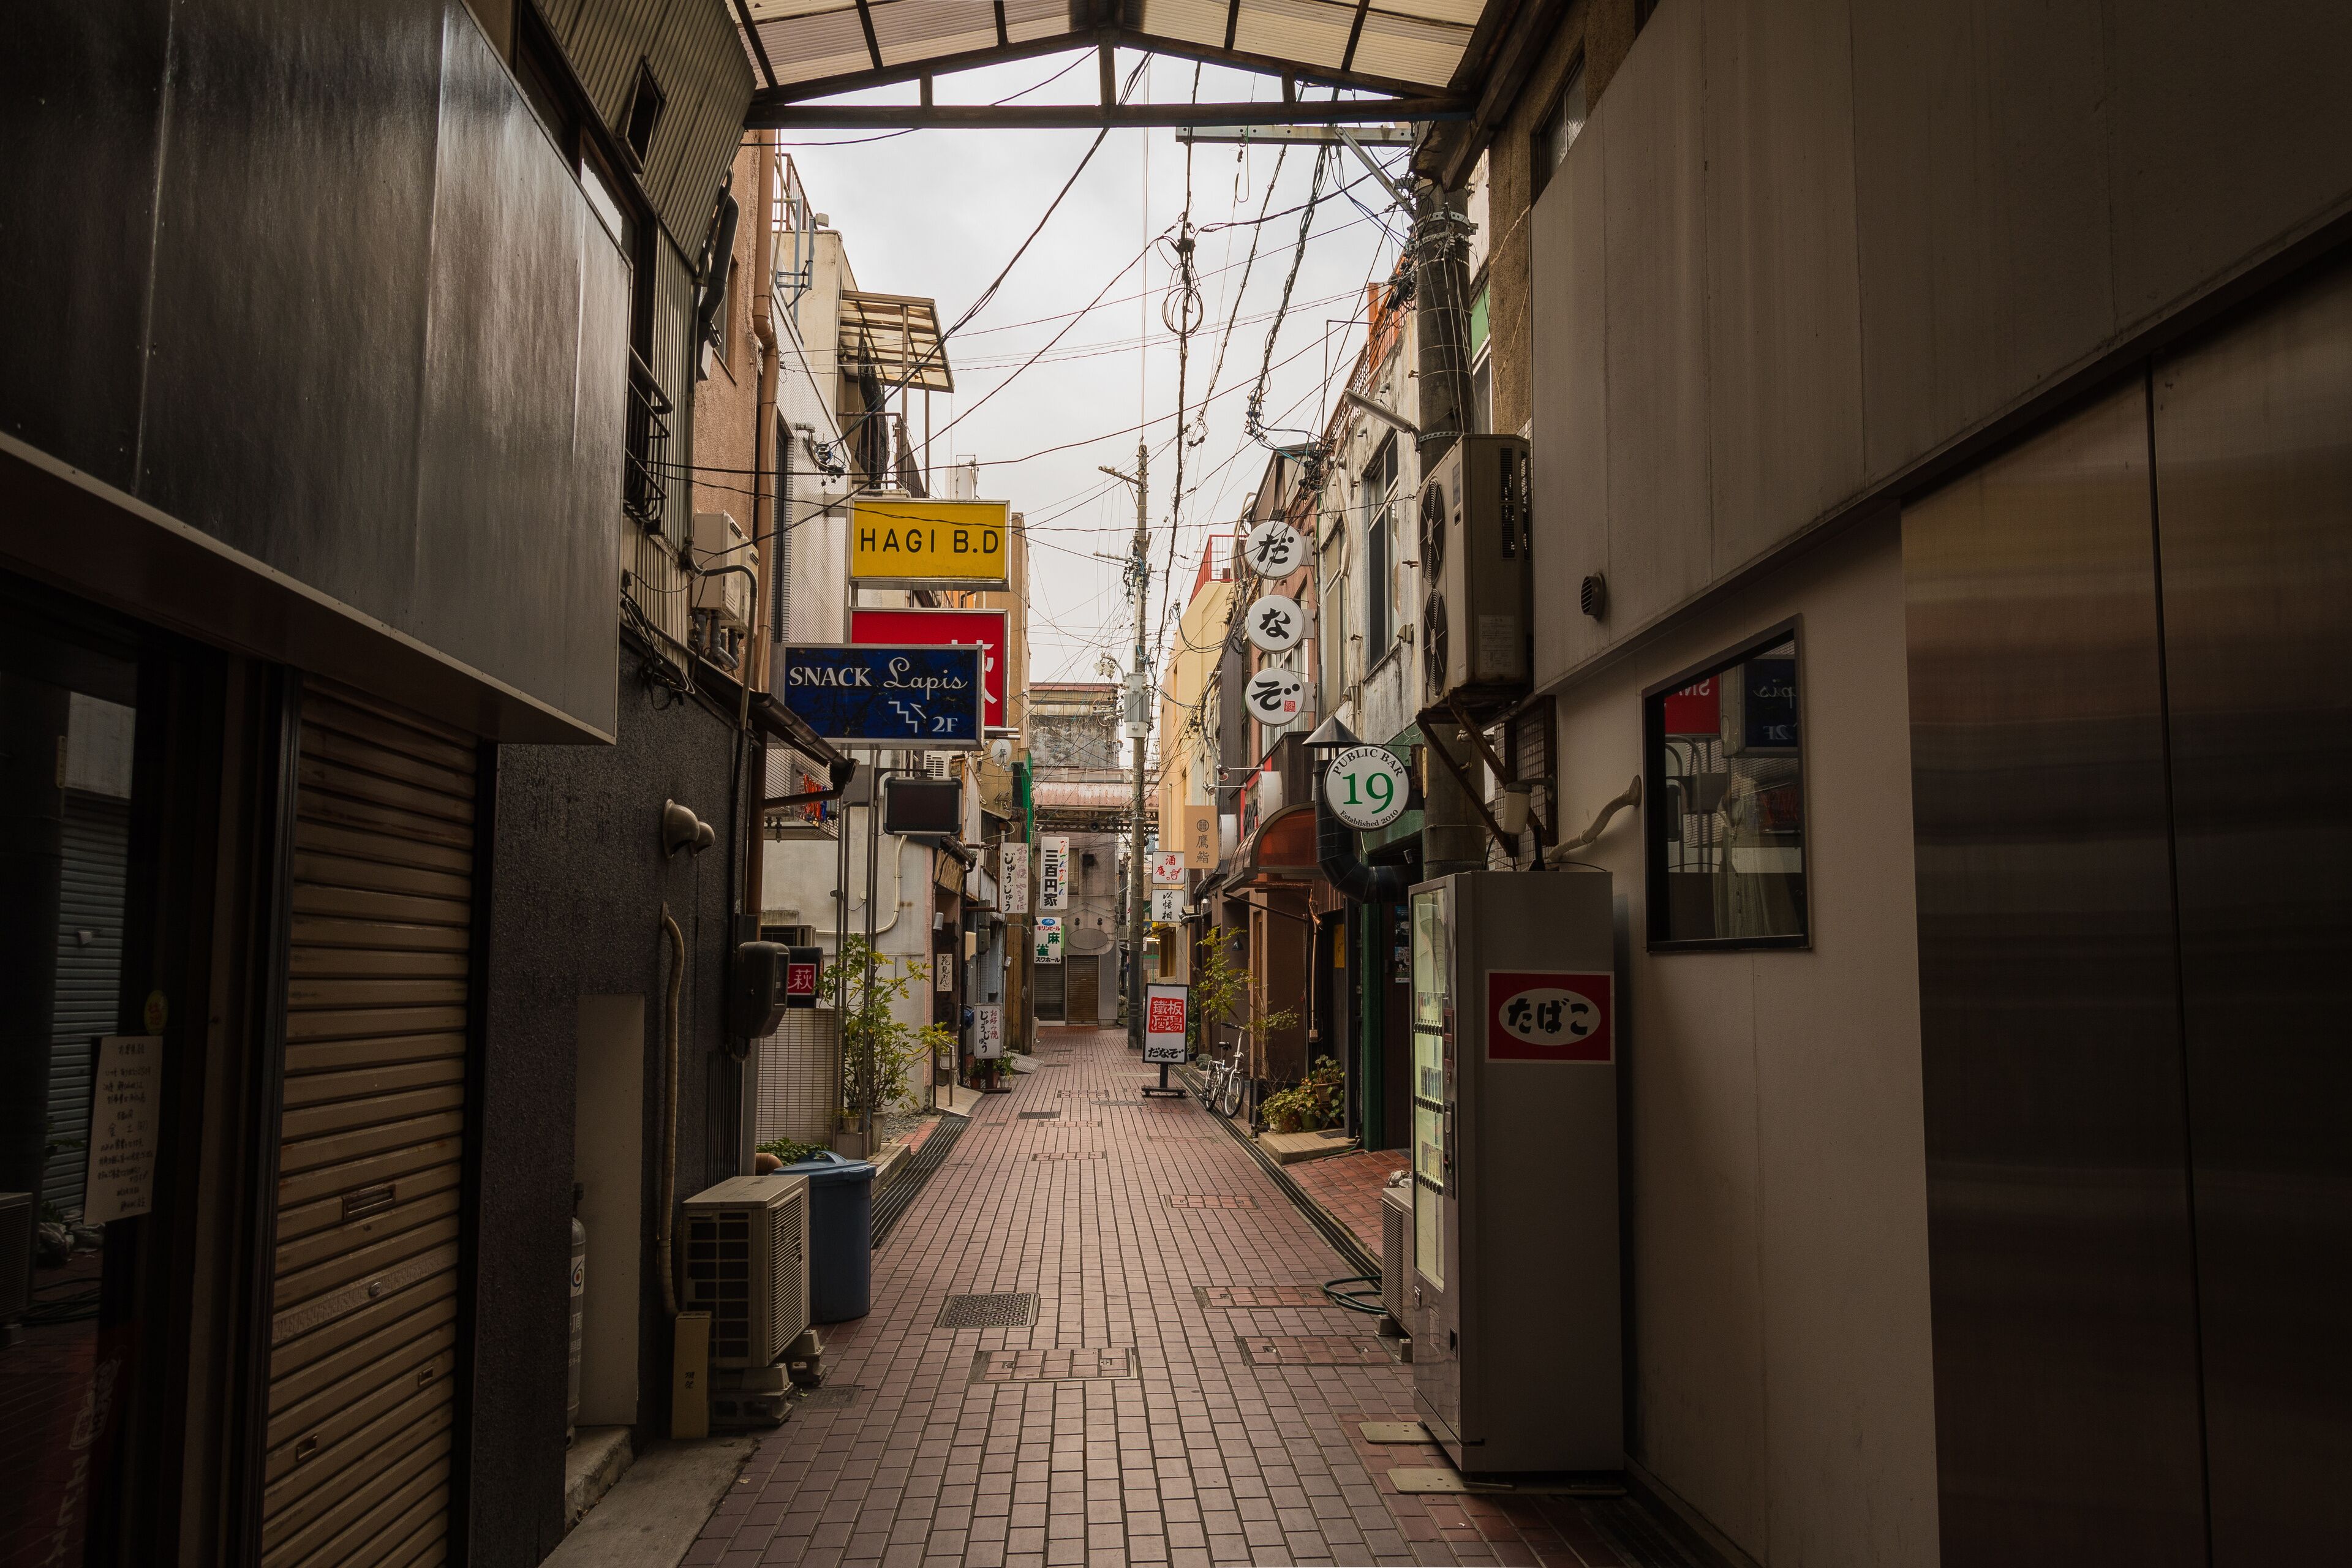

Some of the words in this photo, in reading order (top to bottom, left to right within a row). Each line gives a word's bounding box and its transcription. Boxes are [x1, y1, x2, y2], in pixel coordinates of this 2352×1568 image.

[860, 527, 935, 553] HAGI
[953, 529, 999, 554] B.D
[790, 666, 872, 687] SNACK
[883, 657, 968, 700] Lapis
[932, 716, 958, 733] 2F
[1332, 748, 1378, 776] PUBLIC
[1380, 752, 1403, 777] BAR
[1342, 772, 1393, 815] 19
[1340, 810, 1379, 827] Established
[1381, 809, 1398, 824] 2010
[1004, 852, 1016, 912] じゅうじゅう
[1044, 850, 1059, 907] 三百円家
[979, 1010, 990, 1054] じゅうじゅう
[1152, 1016, 1183, 1031] 酒場
[1507, 998, 1589, 1035] たばこ
[1148, 1047, 1184, 1059] だなぞ
